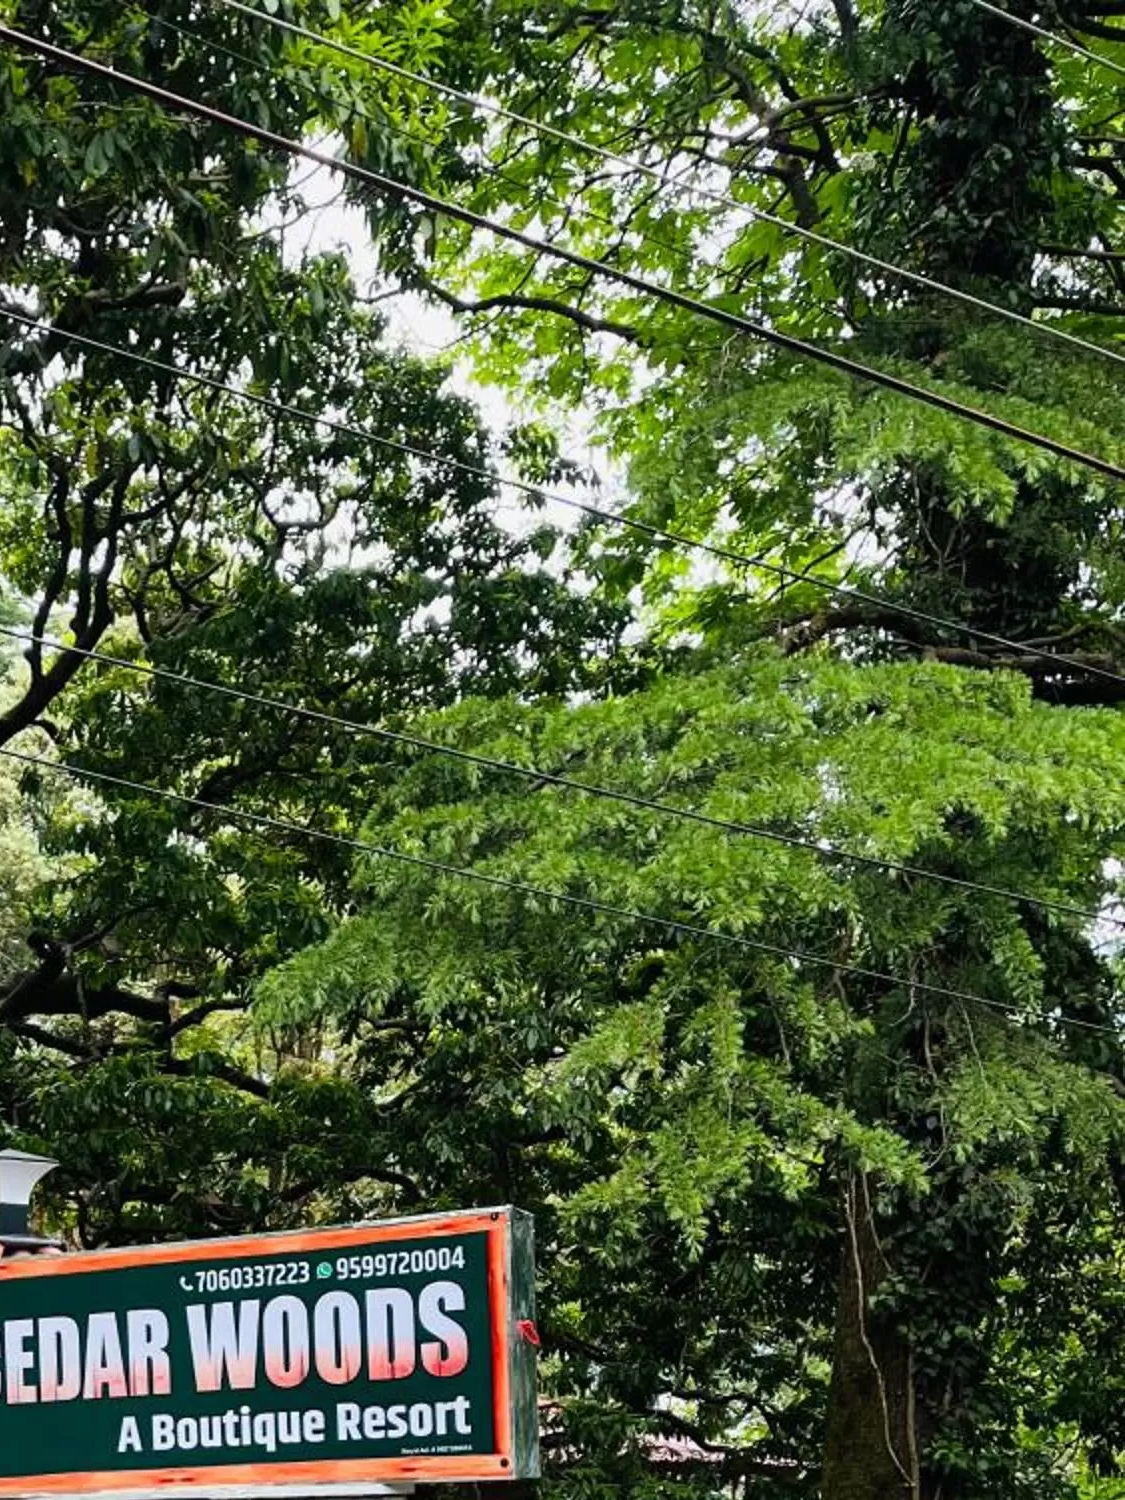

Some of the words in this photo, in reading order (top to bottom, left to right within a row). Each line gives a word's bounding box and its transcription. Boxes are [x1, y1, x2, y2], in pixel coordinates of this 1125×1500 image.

[194, 1261, 311, 1293] 7060337223
[335, 1245, 466, 1280] 9599720004
[185, 1280, 470, 1393] WOODS
[116, 1415, 144, 1453] A
[150, 1405, 327, 1453] Boutique
[335, 1395, 473, 1441] Resort
